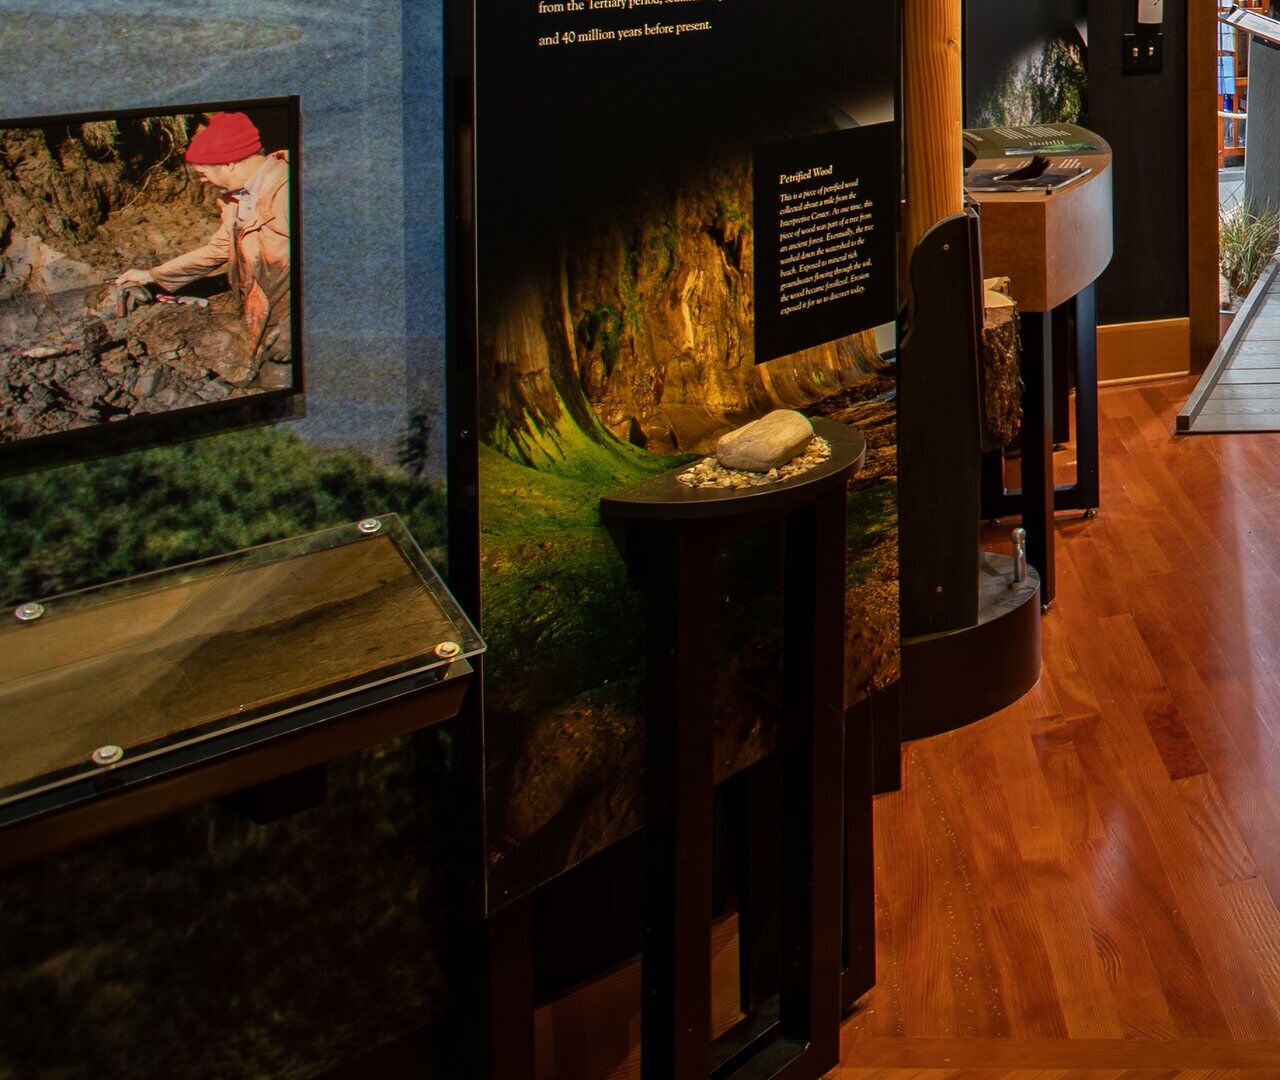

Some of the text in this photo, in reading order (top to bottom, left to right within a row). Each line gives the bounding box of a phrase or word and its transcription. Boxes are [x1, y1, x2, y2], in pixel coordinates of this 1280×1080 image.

[538, 21, 712, 46] and 40 million years before present.
[779, 165, 833, 184] Petrified Wood
